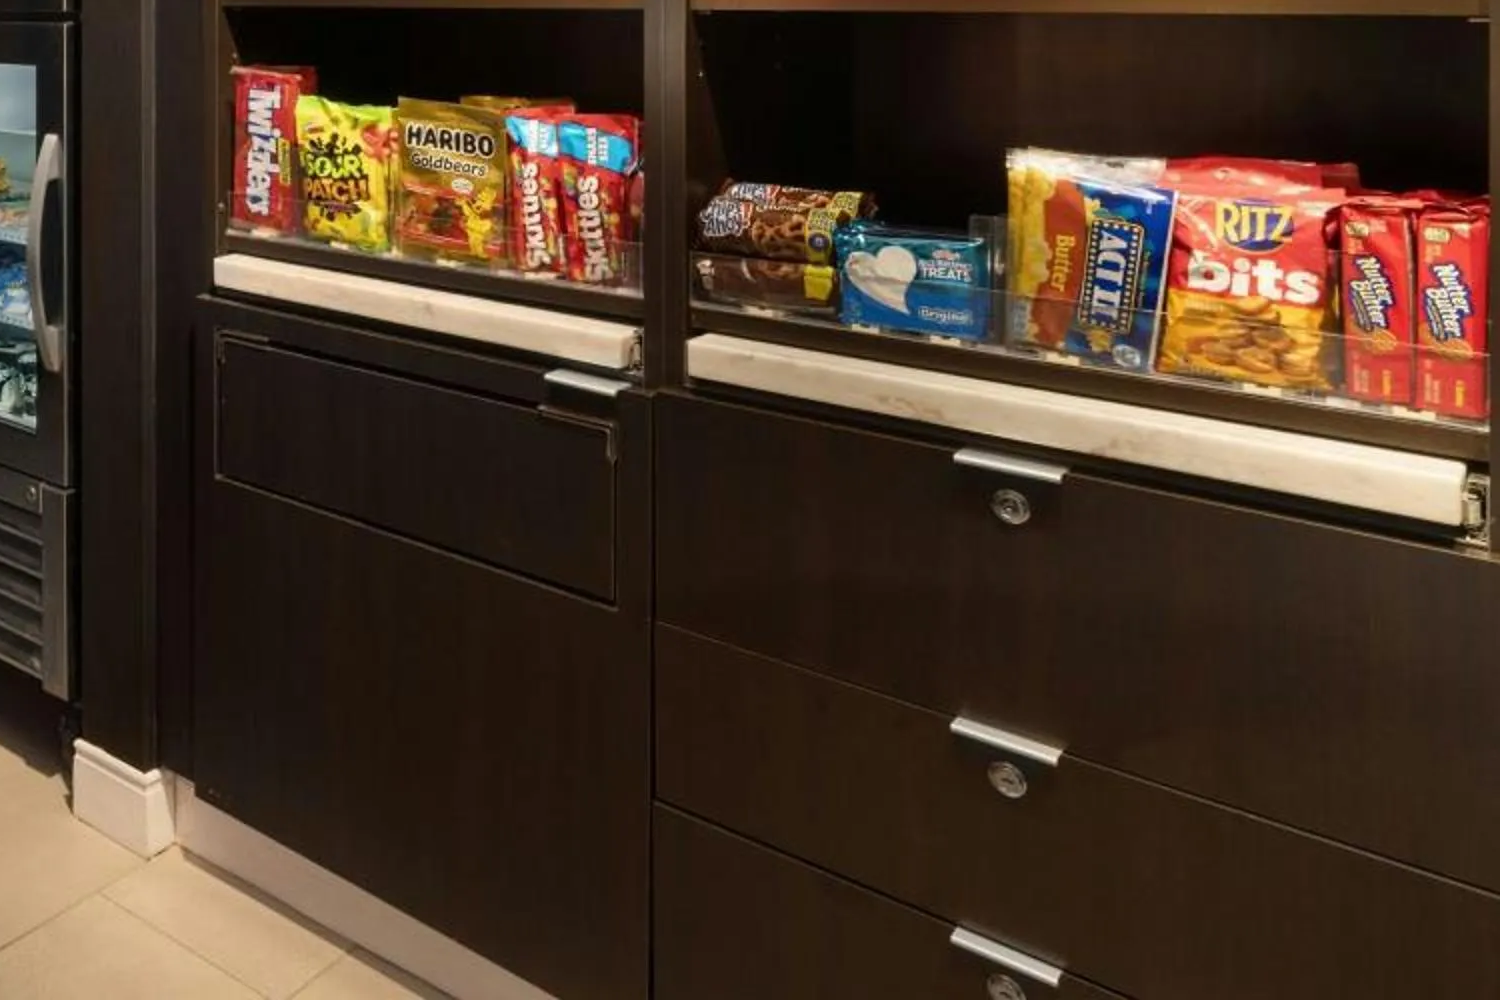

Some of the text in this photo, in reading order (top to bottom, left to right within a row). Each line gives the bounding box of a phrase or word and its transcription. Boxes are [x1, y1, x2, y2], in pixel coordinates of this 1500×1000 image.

[406, 123, 495, 157] HARIBO
[303, 153, 365, 178] SOUR
[304, 177, 370, 201] PATCH
[411, 153, 486, 177] Goldbears
[1214, 202, 1293, 243] RITZ
[1051, 233, 1077, 293] Butter
[1095, 229, 1128, 287] ACT
[1187, 251, 1320, 304] bits
[1355, 256, 1393, 306] Nutter
[1350, 279, 1387, 328] Butter
[1425, 287, 1462, 338] Butter
[1432, 263, 1471, 315] Nutter
